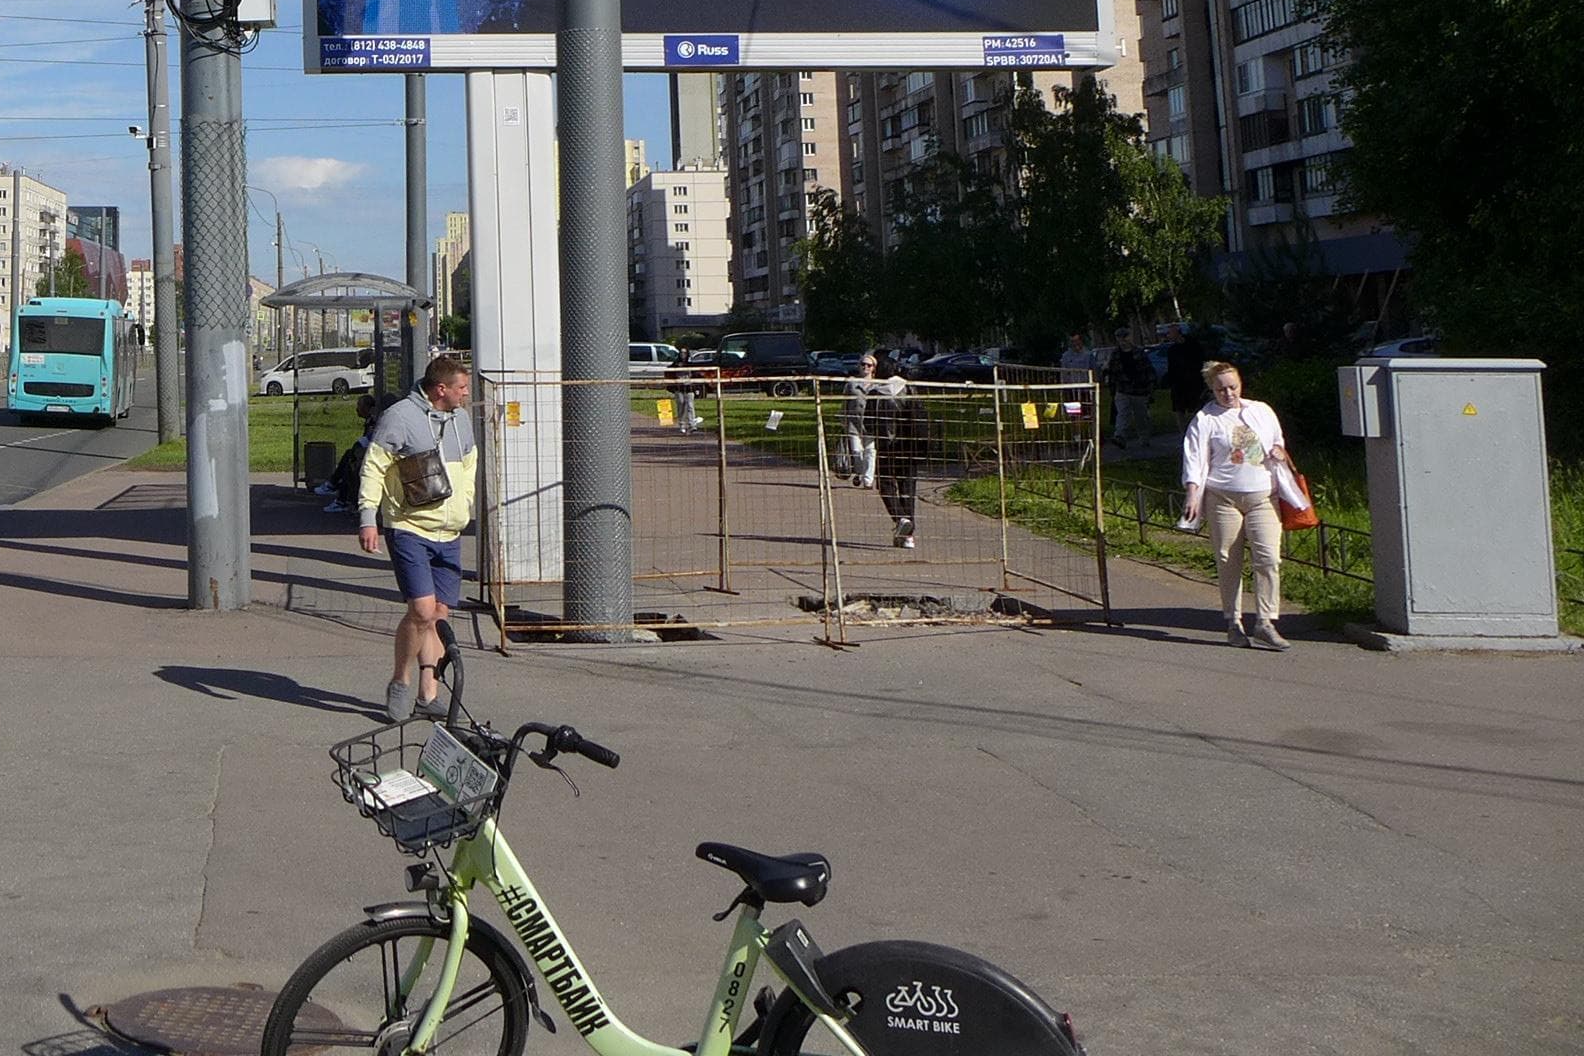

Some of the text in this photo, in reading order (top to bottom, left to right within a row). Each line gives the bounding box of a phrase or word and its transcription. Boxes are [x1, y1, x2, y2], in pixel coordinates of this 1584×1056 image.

[350, 40, 376, 51] (812)
[377, 40, 426, 50] 438-4848
[697, 44, 729, 56] Russ
[496, 884, 611, 1038] #СМАРТБАЙК
[718, 961, 746, 1034] 0827
[887, 1015, 961, 1034] SMART BIKE
